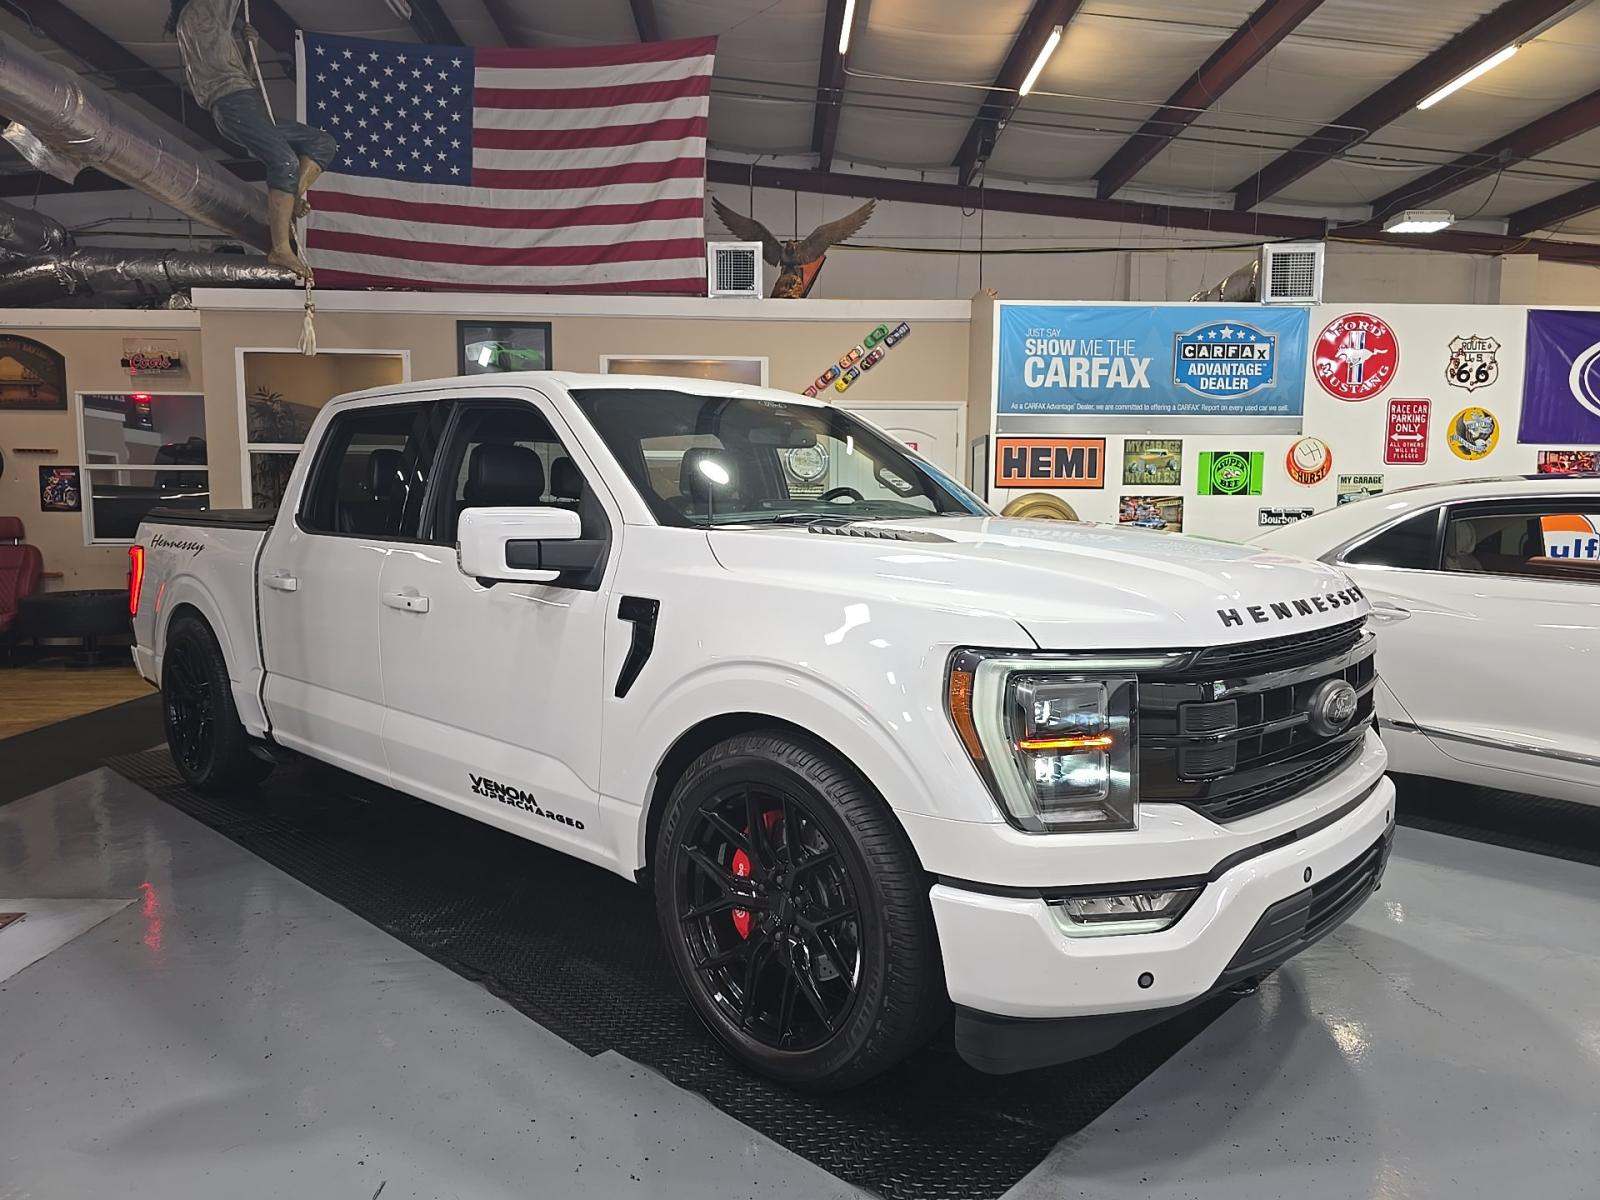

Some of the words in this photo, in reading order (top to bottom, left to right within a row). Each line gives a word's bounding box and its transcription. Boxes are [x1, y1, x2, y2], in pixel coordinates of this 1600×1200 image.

[1025, 328, 1044, 337] JUST
[1046, 328, 1061, 337] SAY
[1333, 320, 1386, 338] FORD
[1025, 338, 1076, 356] SHOW
[1080, 339, 1103, 356] ME
[1106, 339, 1136, 356] THE
[1183, 345, 1268, 360] CARFAX
[1462, 341, 1487, 351] ROUTE
[1024, 356, 1151, 388] CARFAX
[1188, 363, 1262, 376] ADVANTAGE
[1457, 362, 1489, 383] 66
[1200, 377, 1249, 390] DEALER
[1319, 362, 1389, 394] MUSTANG
[1391, 404, 1411, 414] RACE
[1412, 404, 1428, 414] CAR
[1391, 414, 1427, 423] PARKING
[1395, 423, 1420, 433] ONLY
[1126, 441, 1141, 453] MY
[1002, 446, 1099, 479] HEMI
[1218, 458, 1244, 471] SUPER
[1125, 472, 1142, 484] MY
[1297, 466, 1326, 484] HURST
[1340, 476, 1352, 484] MY
[1353, 476, 1382, 484] GARAGE
[1261, 512, 1298, 524] Bourbon
[151, 534, 205, 557] Hennessey
[1550, 538, 1599, 558] ulf
[468, 772, 538, 807] VENOM
[471, 785, 585, 830] SUPERCHARGED
